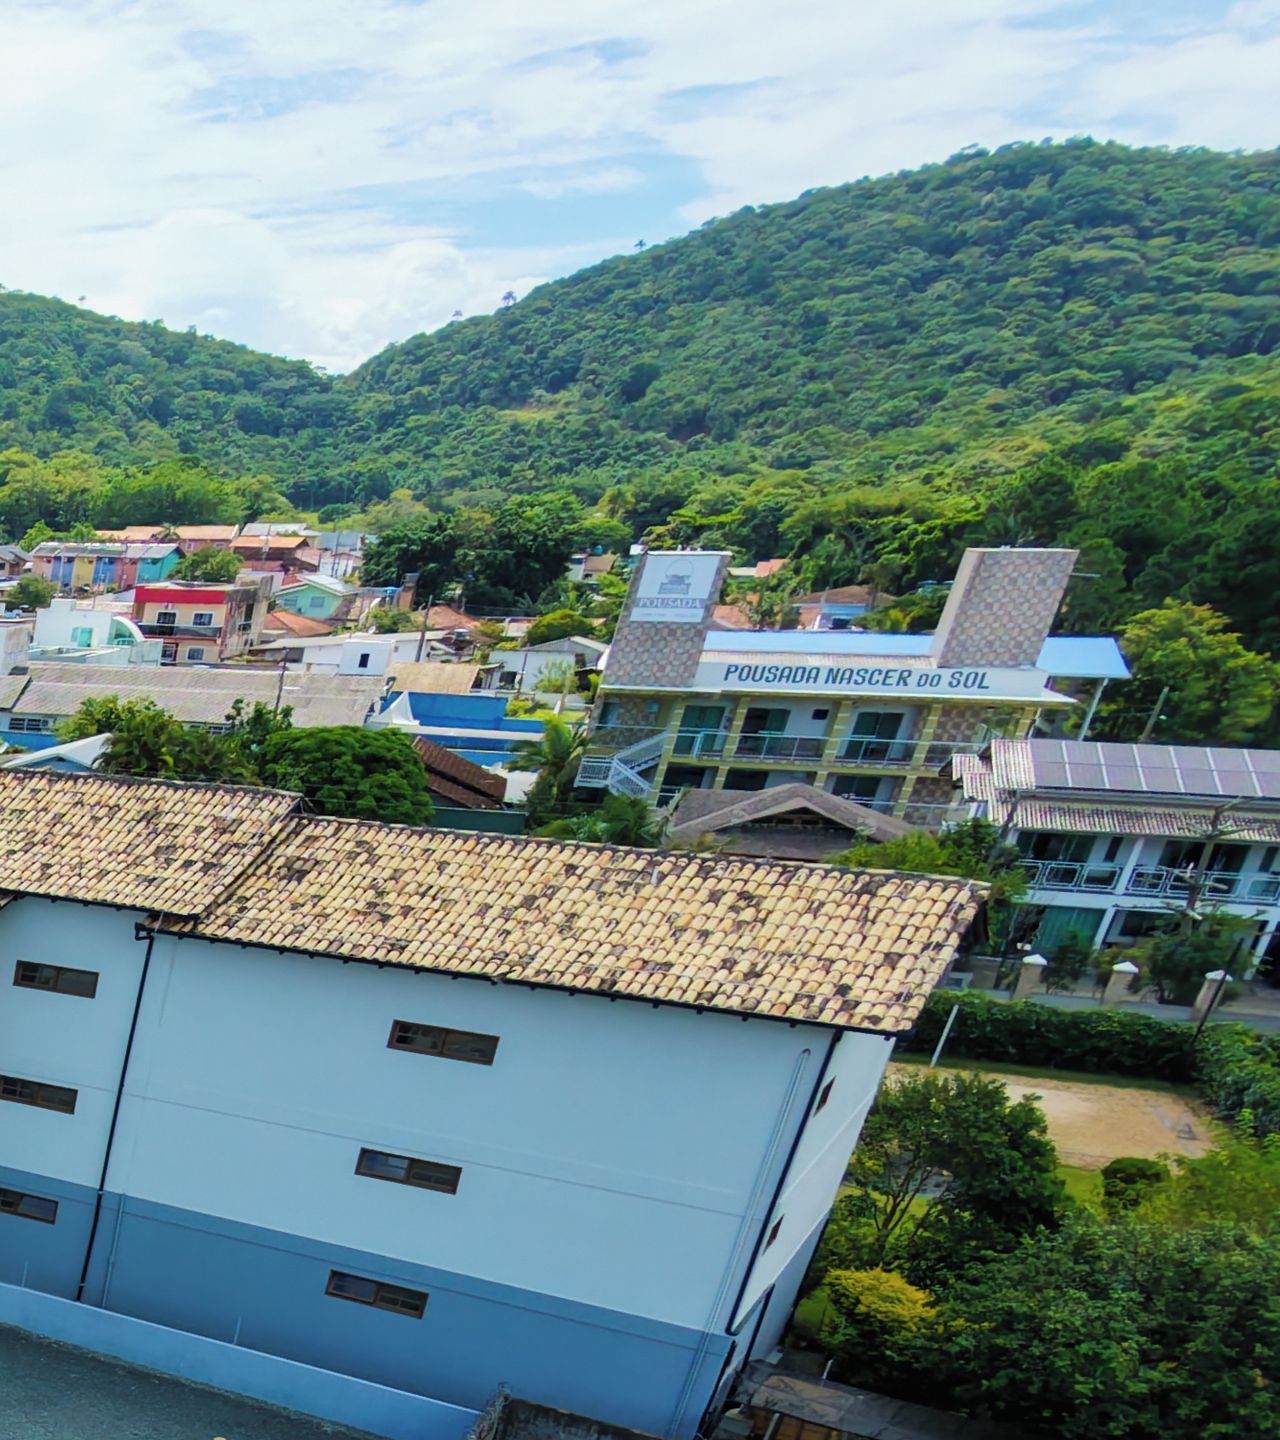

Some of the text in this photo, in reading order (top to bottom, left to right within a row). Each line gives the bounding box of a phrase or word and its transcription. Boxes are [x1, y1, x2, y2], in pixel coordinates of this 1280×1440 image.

[724, 664, 820, 684] POUSADA
[824, 667, 912, 687] NASCER
[948, 671, 990, 689] SOL
